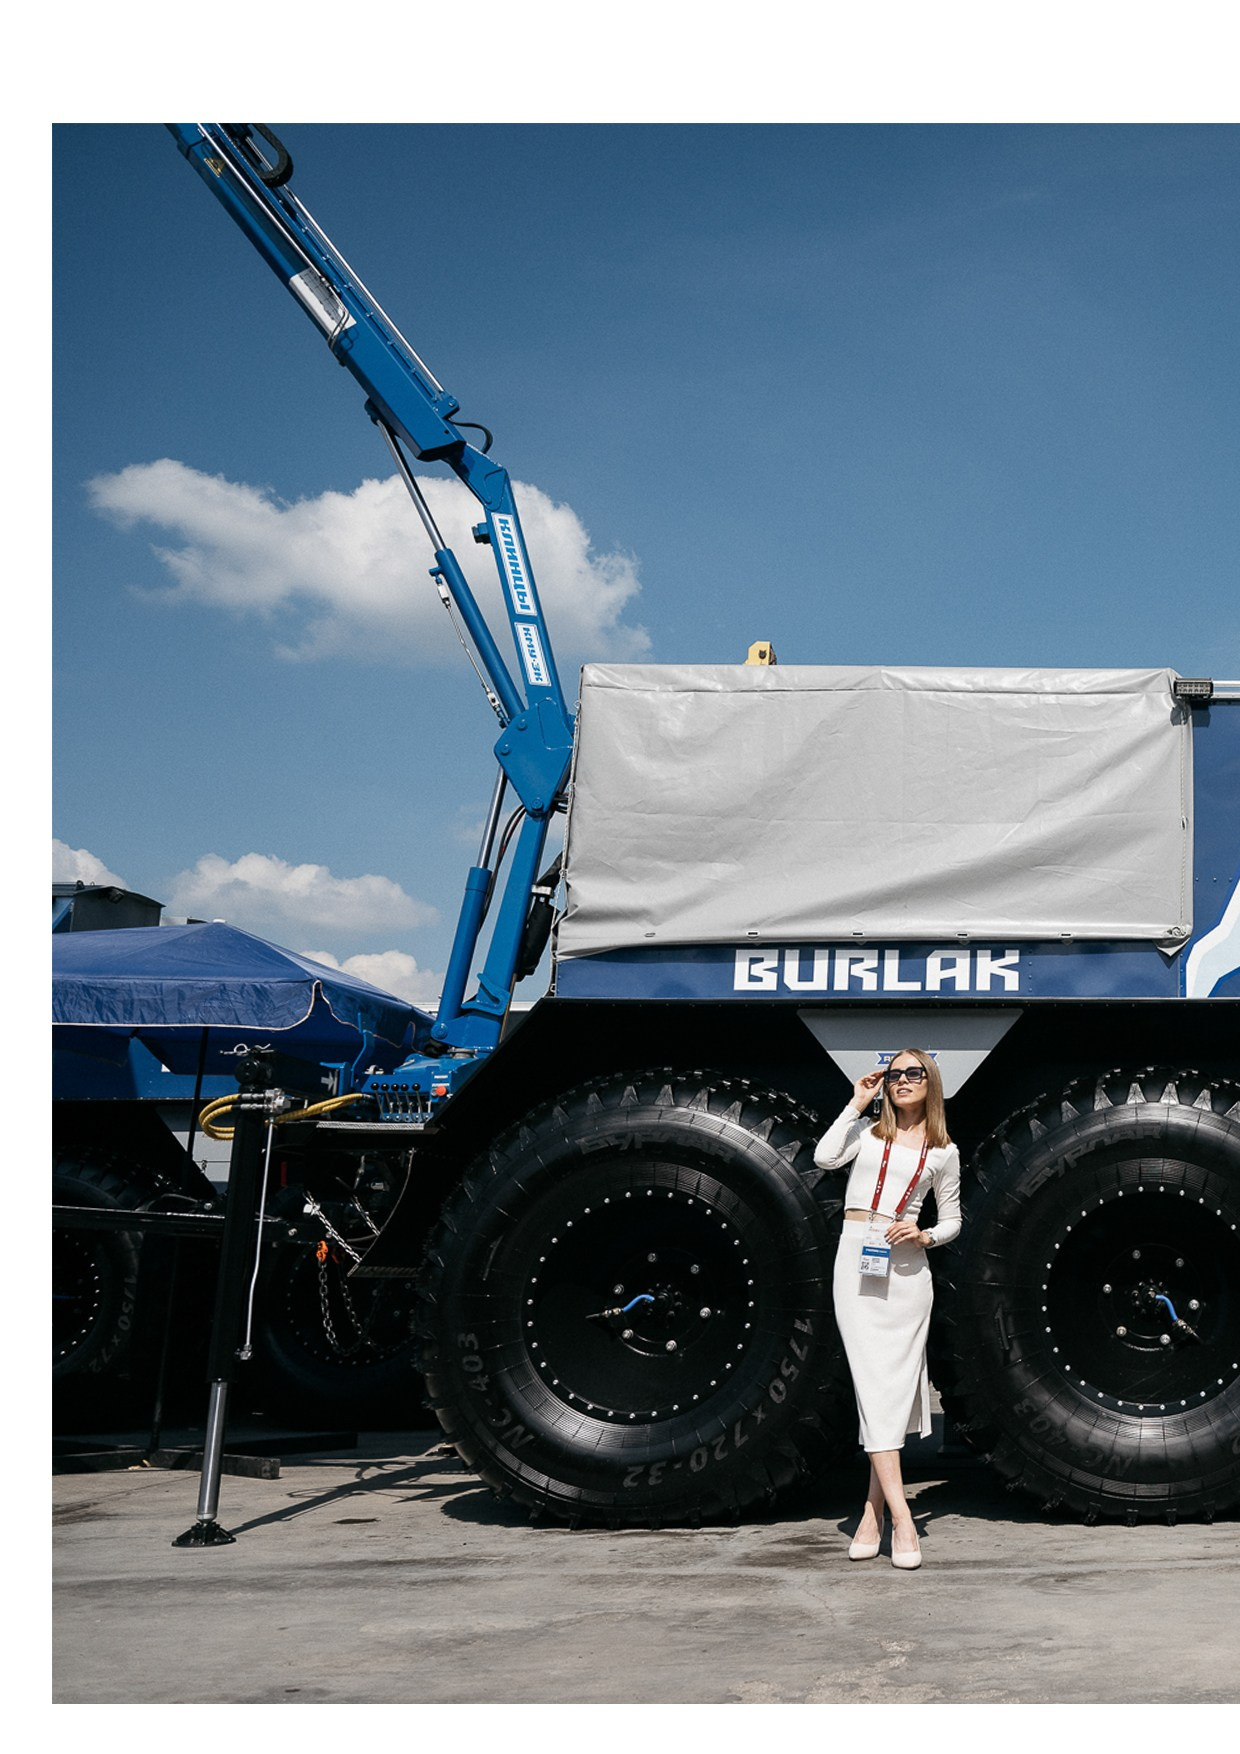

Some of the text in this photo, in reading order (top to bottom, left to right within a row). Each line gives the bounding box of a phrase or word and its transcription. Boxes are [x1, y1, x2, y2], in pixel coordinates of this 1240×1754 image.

[498, 518, 531, 611] КЛИНЦЫ
[733, 949, 1020, 991] BURLAK
[457, 1331, 536, 1451] NC-403
[768, 1317, 814, 1405] 1750
[622, 1421, 750, 1490] 720-32
